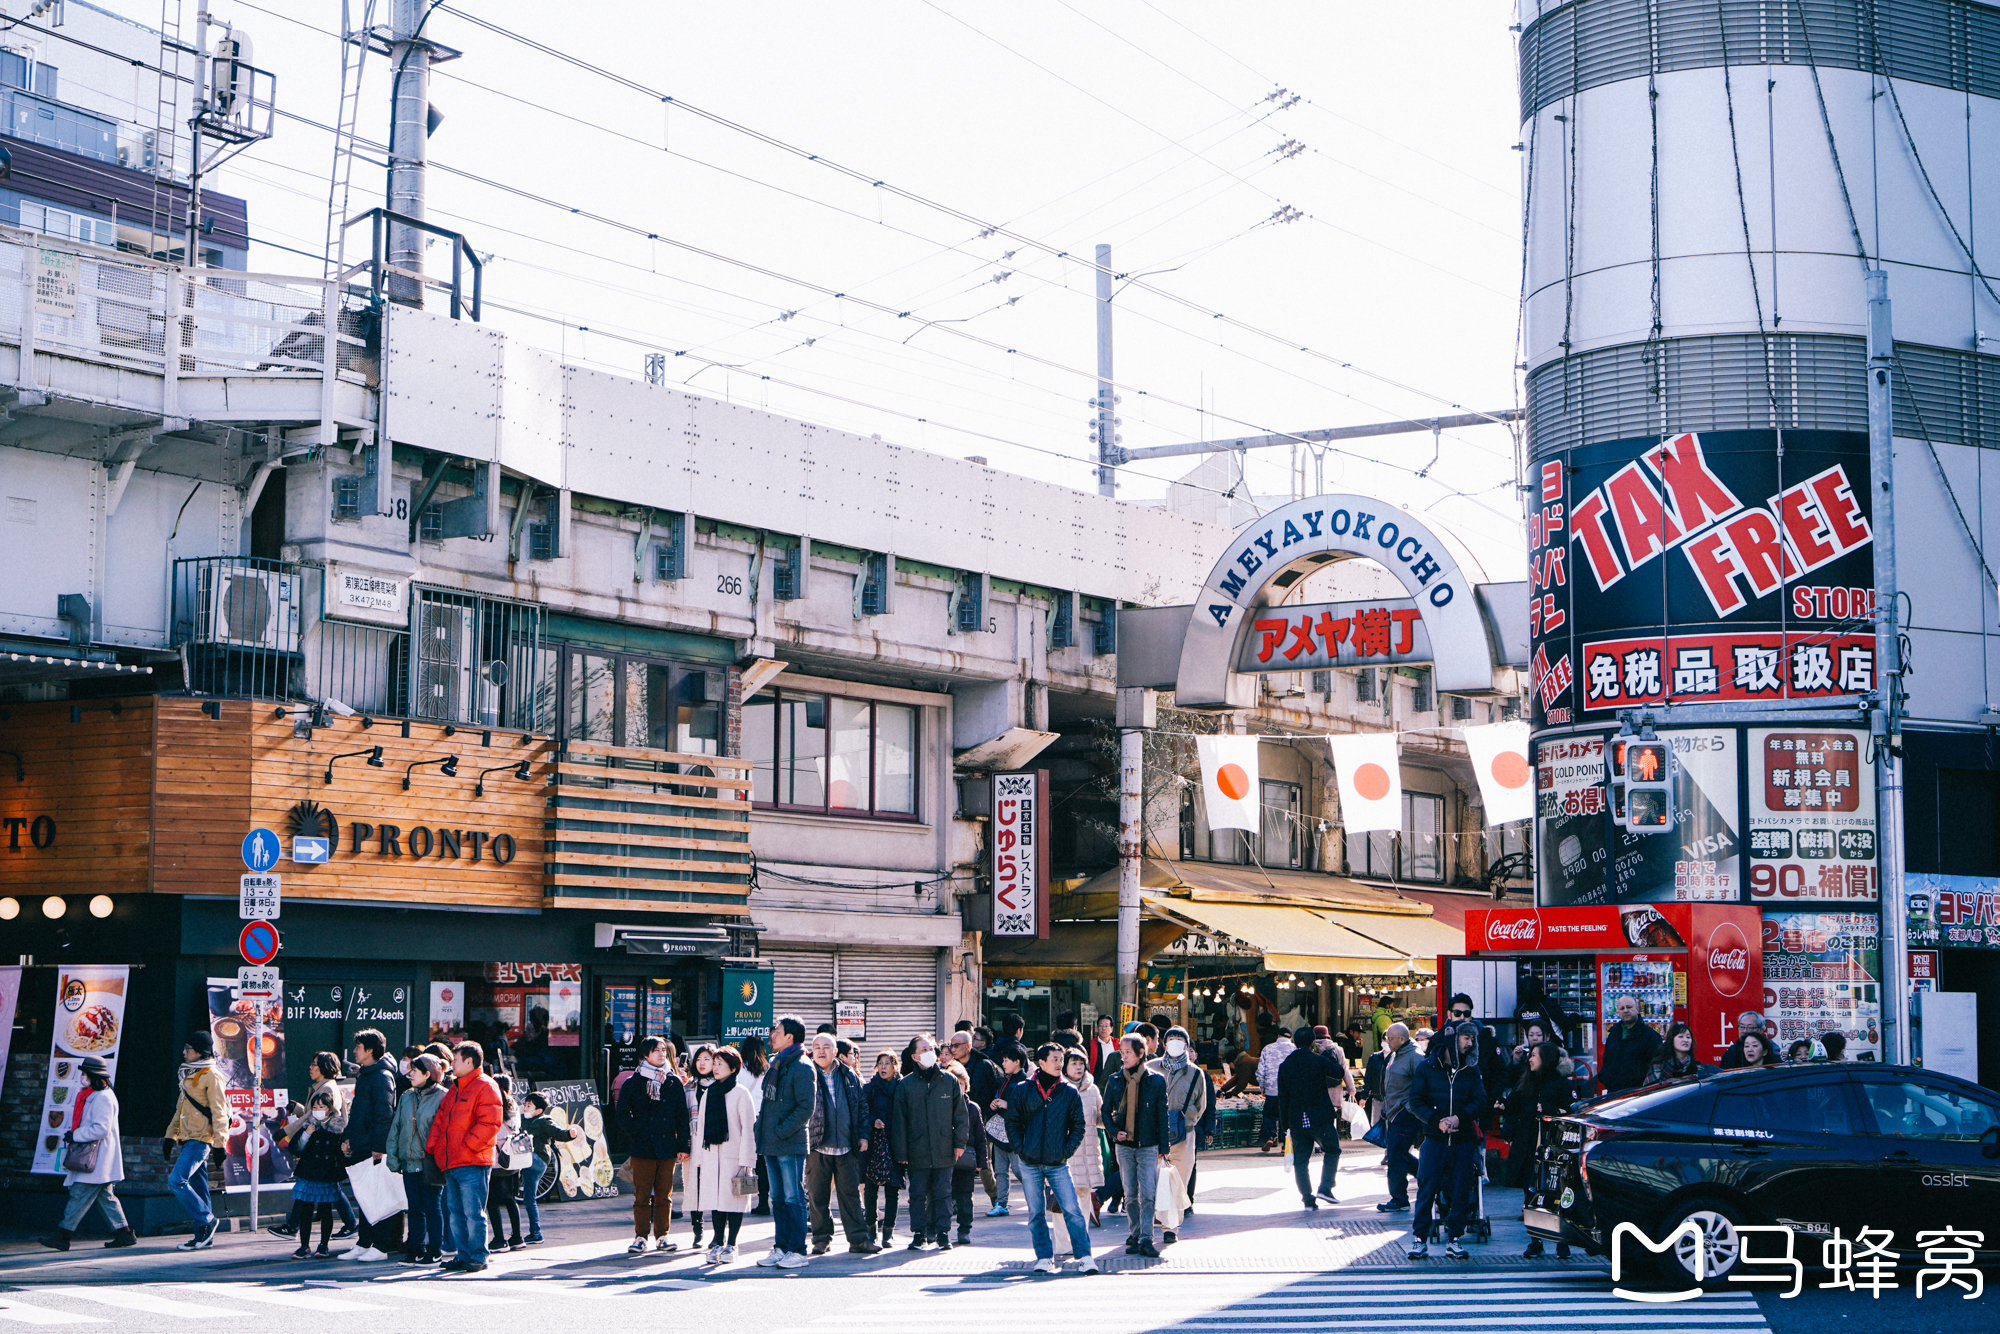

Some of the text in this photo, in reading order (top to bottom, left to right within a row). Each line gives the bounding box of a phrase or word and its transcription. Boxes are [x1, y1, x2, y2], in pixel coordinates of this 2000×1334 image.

[47, 269, 68, 279] お願い
[1570, 433, 1745, 593] TAX
[1541, 458, 1566, 634] ヨドバシ
[1680, 463, 1874, 619] FREE
[1207, 509, 1455, 628] AMEYAYOKOCHO
[717, 574, 743, 597] 266
[349, 593, 392, 608] 3K472M48
[1253, 607, 1423, 664] アメヤ横丁
[1530, 641, 1551, 701] TAX
[1588, 645, 1874, 701] 免税品取扱店
[1540, 653, 1572, 713] FREE
[1547, 707, 1571, 726] STORE
[1537, 740, 1604, 763] ヨドバシカメラ
[1769, 739, 1855, 751] 年会費・入会金
[1795, 751, 1826, 765] 無料
[1554, 763, 1604, 780] GOLD POINT
[1772, 768, 1852, 788] 新規会員
[1783, 789, 1843, 807] 募集中
[350, 821, 517, 865] PRONTO
[1681, 831, 1735, 860] VISA
[1750, 831, 1791, 850] 盗難
[1799, 831, 1835, 850] 破損
[1841, 833, 1873, 850] 水没
[996, 799, 1018, 910] じゅらく
[1020, 799, 1031, 910] 東京名物 レストラン
[1762, 849, 1779, 857] から
[1809, 849, 1825, 858] から
[1849, 850, 1864, 858] から
[1675, 861, 1717, 875] 店内で
[243, 877, 277, 887] 自転車を除く
[1675, 875, 1732, 888] 即時発行
[245, 887, 256, 897] 13
[267, 887, 273, 897] 6
[1675, 888, 1738, 902] 致します!
[245, 907, 256, 917] 12
[267, 907, 273, 917] 6
[1819, 915, 1876, 924] ヨドバシカメラ
[1488, 918, 1538, 940] Coca-Cola
[1547, 925, 1567, 933] TASTE
[1567, 925, 1580, 933] THE
[1906, 928, 1940, 940] らっしゃいませ
[1948, 928, 1983, 943] 友都八喜
[671, 944, 696, 952] PRONTO
[1709, 947, 1747, 970] Coca-Cola
[1912, 954, 1930, 966] 欢迎
[243, 971, 249, 980] 6
[67, 986, 83, 996] 極太
[240, 980, 275, 989] 貨物を除く
[1779, 987, 1837, 999] ゲーム・ソフト
[287, 1006, 342, 1019] B1F 19seats
[356, 1008, 404, 1020] 2F 24seats
[734, 1011, 762, 1019] PRONTO
[724, 1026, 771, 1037] 上野しのばず口店
[1780, 1019, 1842, 1030] おもちゃ・ホビー
[1713, 1127, 1774, 1139] 深夜割増なし
[1921, 1172, 1970, 1188] assist
[1807, 1223, 1829, 1232] 604
